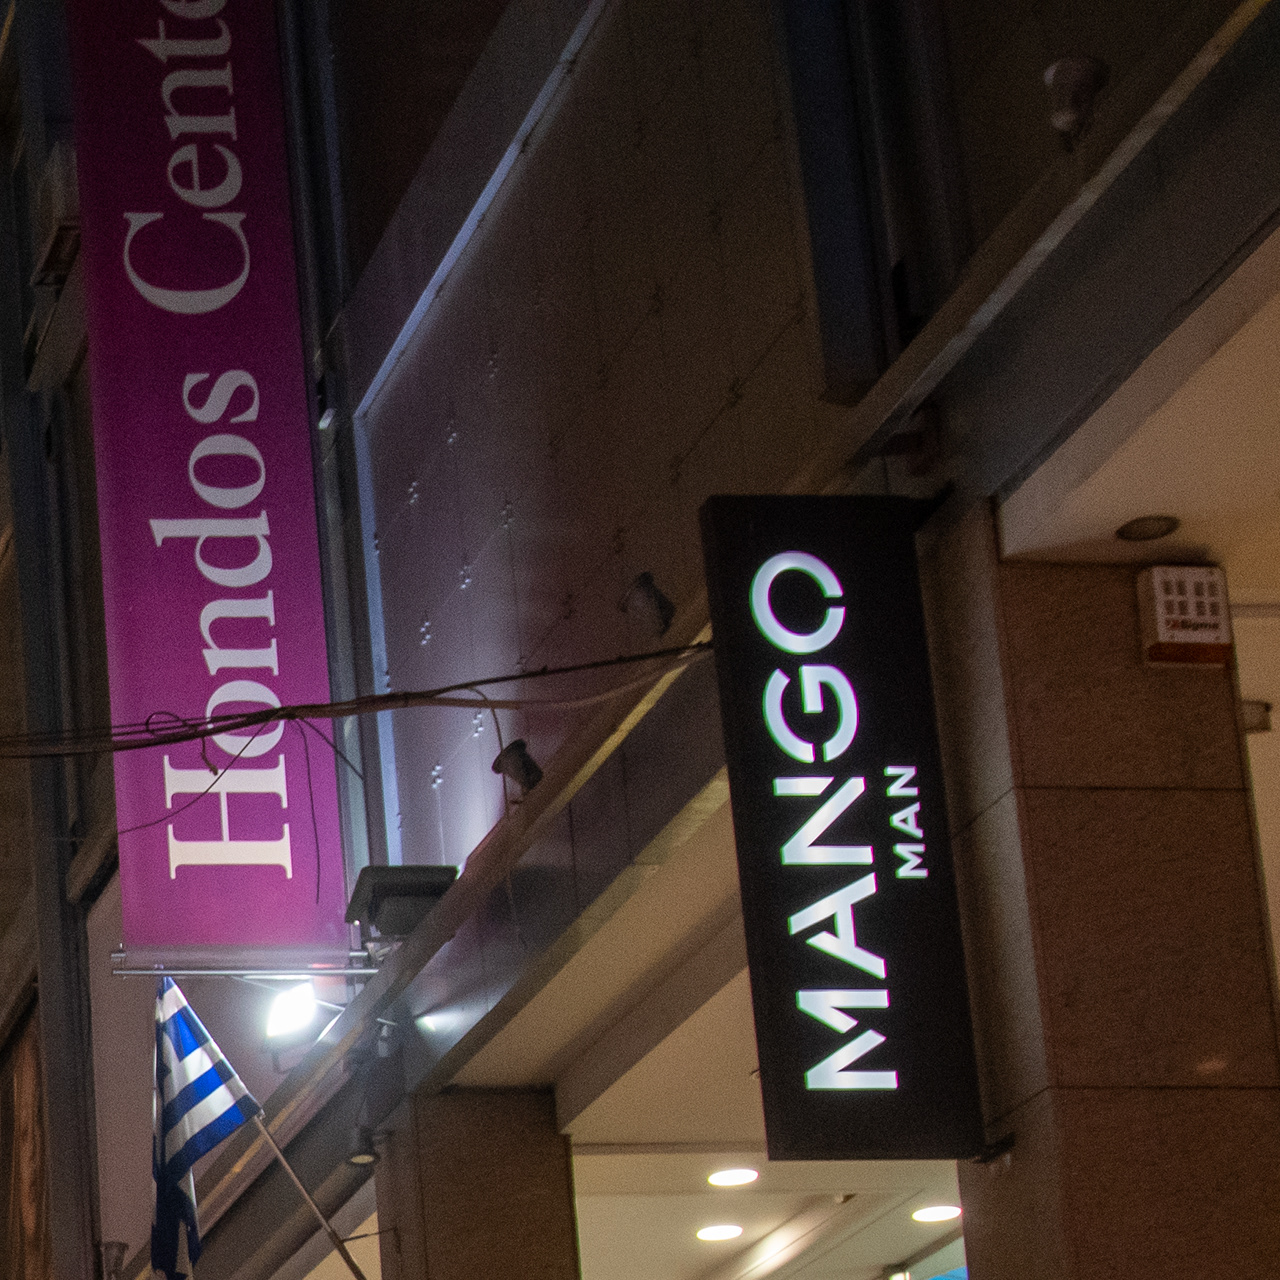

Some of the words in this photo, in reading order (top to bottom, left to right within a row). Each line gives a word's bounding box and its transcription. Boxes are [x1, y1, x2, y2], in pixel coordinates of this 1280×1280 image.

[123, 0, 252, 316] Cent
[149, 369, 294, 880] Hondos
[749, 550, 898, 1090] MANGO
[884, 765, 928, 878] MAN
